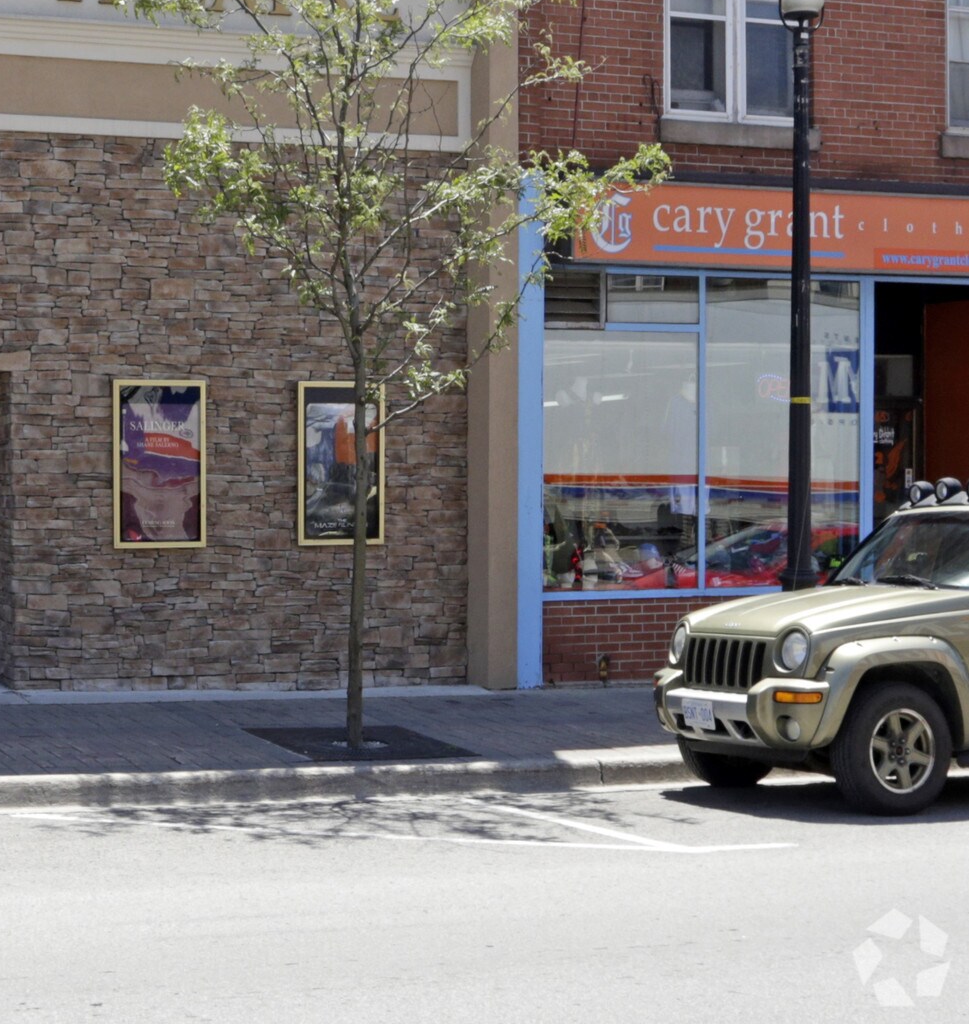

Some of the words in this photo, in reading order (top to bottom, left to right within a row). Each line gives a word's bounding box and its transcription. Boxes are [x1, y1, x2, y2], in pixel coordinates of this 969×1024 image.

[653, 204, 735, 248] cary
[758, 378, 790, 398] OPE
[129, 421, 186, 431] SALINGER
